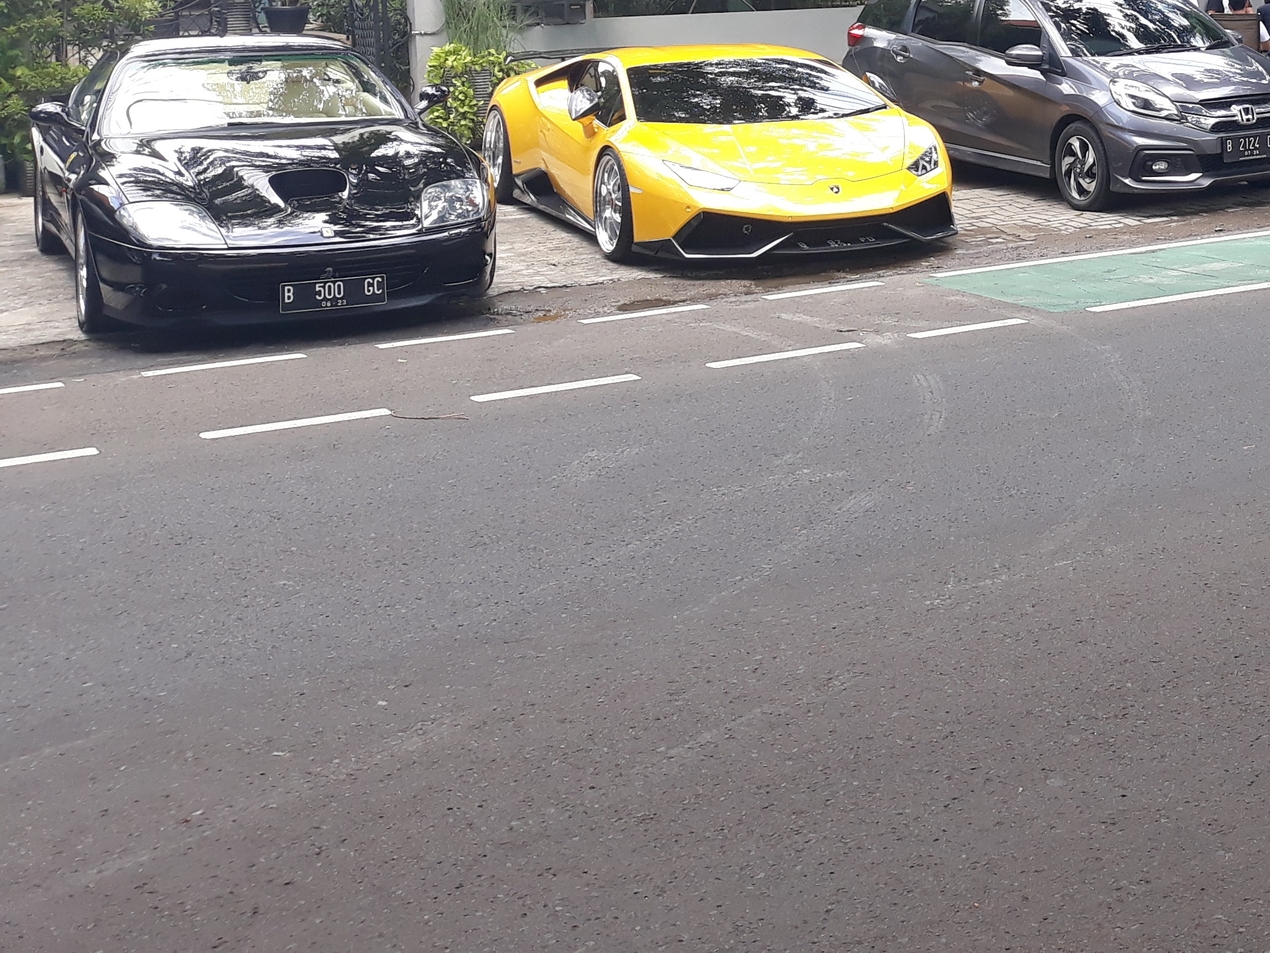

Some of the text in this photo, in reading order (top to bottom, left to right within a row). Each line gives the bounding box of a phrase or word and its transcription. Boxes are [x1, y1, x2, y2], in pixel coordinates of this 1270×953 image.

[1226, 139, 1233, 152] B
[1239, 136, 1260, 151] 2124
[284, 277, 383, 304] B 500 GC
